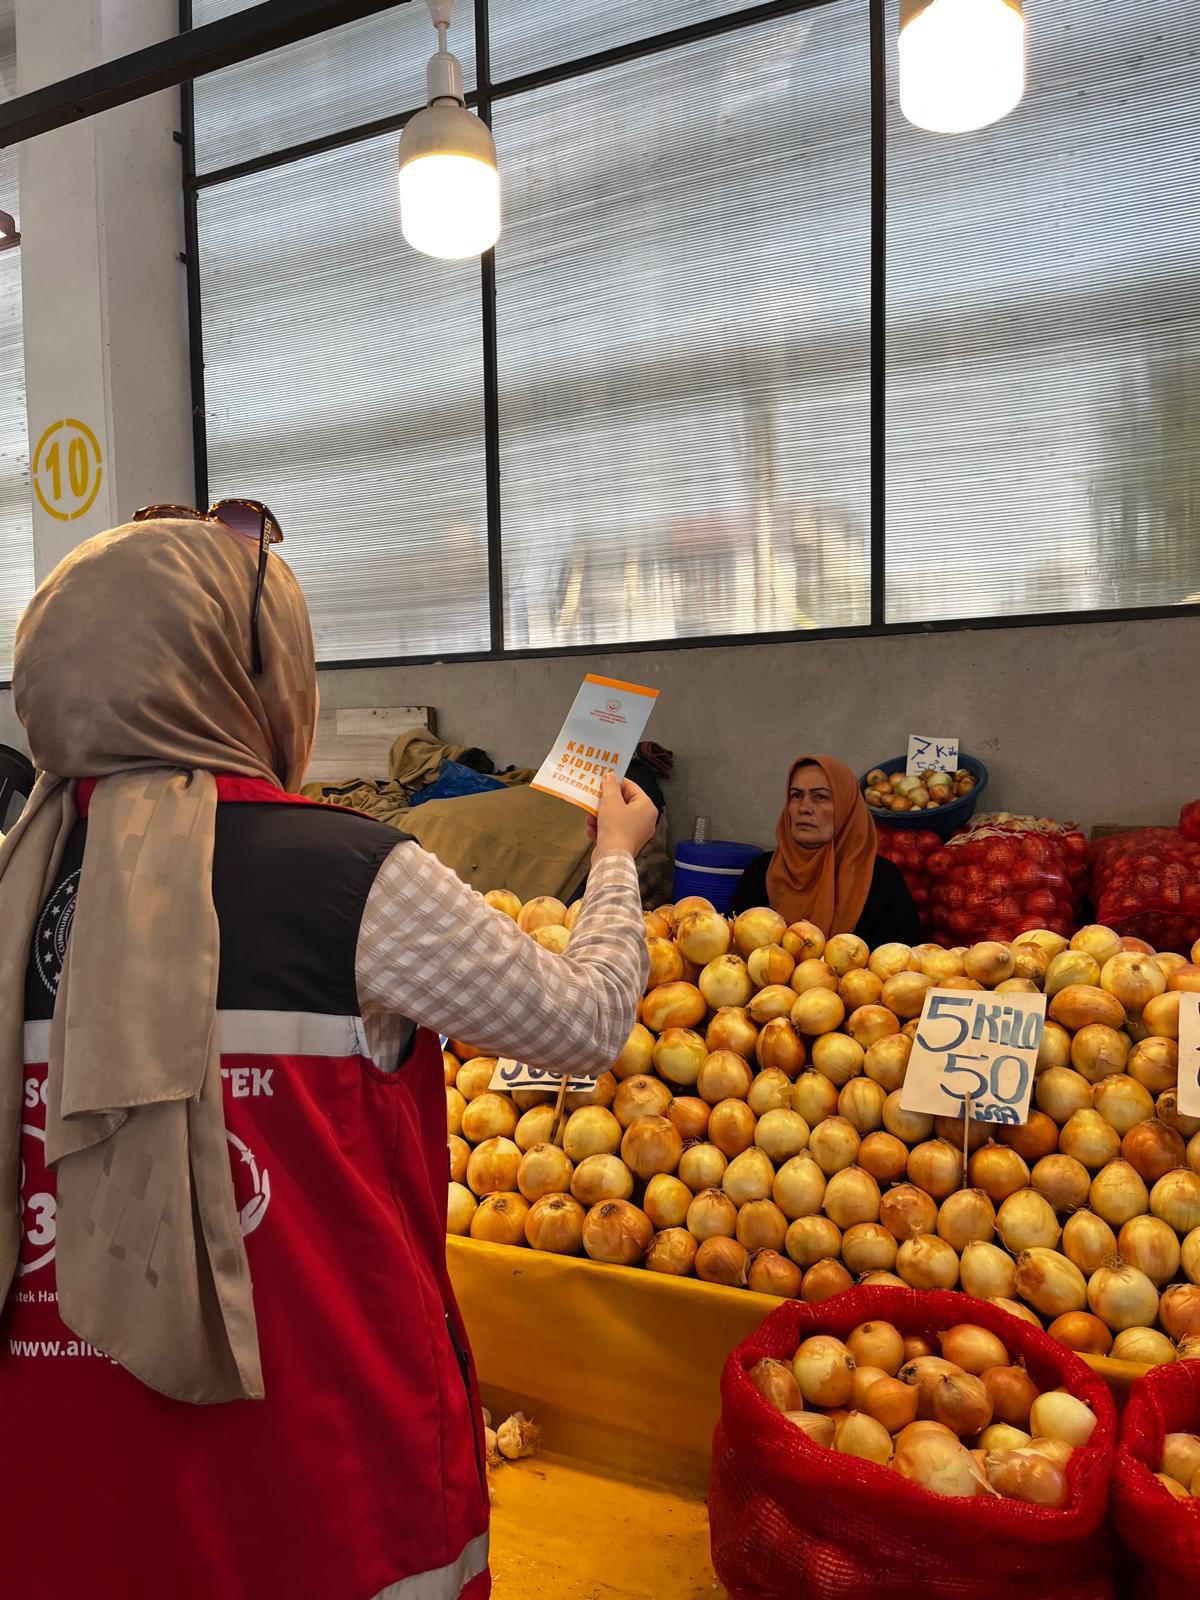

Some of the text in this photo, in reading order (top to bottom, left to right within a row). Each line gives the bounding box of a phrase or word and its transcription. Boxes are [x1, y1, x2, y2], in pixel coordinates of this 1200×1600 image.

[45, 437, 89, 501] 10
[567, 740, 619, 764] KADINA
[911, 737, 932, 760] 7
[556, 764, 602, 788] SIFI
[917, 995, 973, 1052] 5
[940, 1053, 1029, 1104] 50
[22, 1192, 57, 1246] 3
[16, 1290, 35, 1302] tek
